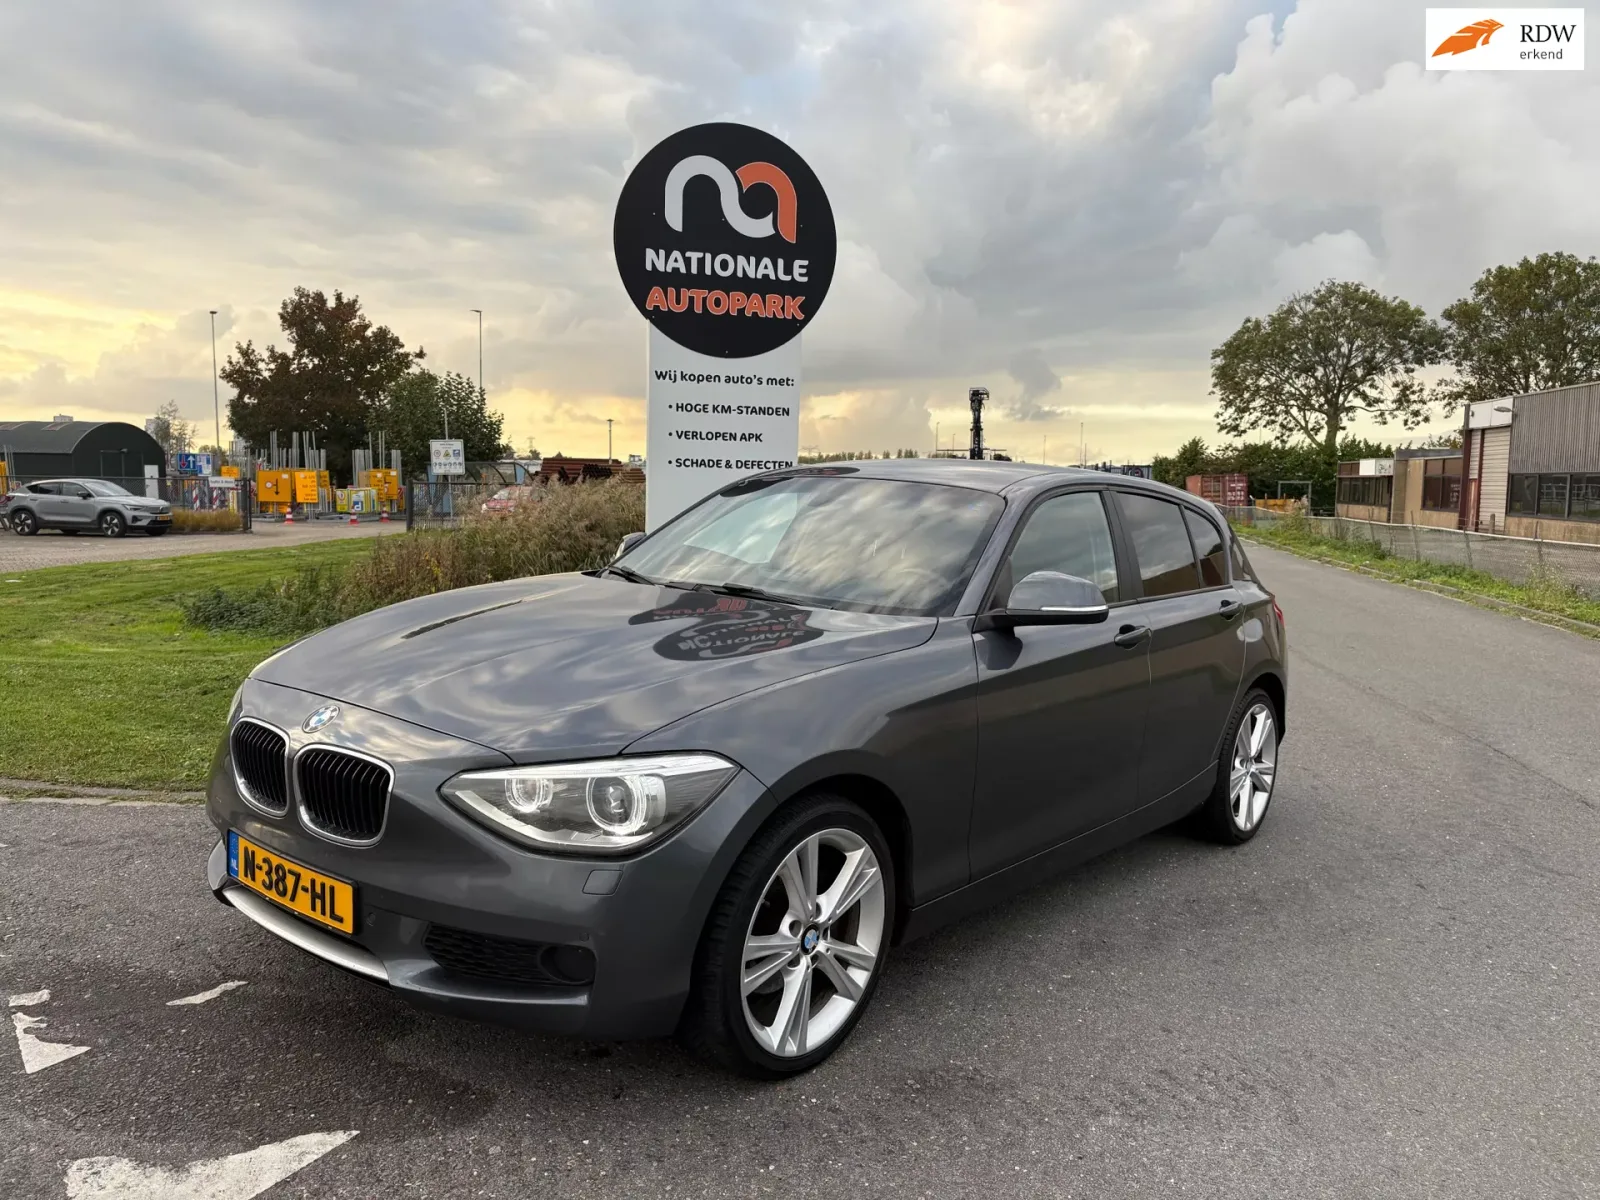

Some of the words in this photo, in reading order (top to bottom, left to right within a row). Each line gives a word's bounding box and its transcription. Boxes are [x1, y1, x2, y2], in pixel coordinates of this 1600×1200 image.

[645, 247, 809, 283] NATIONALE
[645, 286, 806, 320] AUTOPARK
[654, 370, 677, 384] Wij
[680, 371, 721, 384] kopen
[724, 374, 763, 386] auto's
[766, 376, 795, 387] met:
[675, 402, 709, 413] HOGE
[712, 404, 790, 417] KM-STANDEN
[675, 430, 737, 442] VERLOPEN
[739, 432, 763, 443] APK
[675, 458, 723, 469] SCHADE
[724, 459, 733, 469] &
[735, 459, 793, 470] DEFECTEN
[231, 857, 238, 870] NL
[243, 845, 344, 924] N-387-HL
